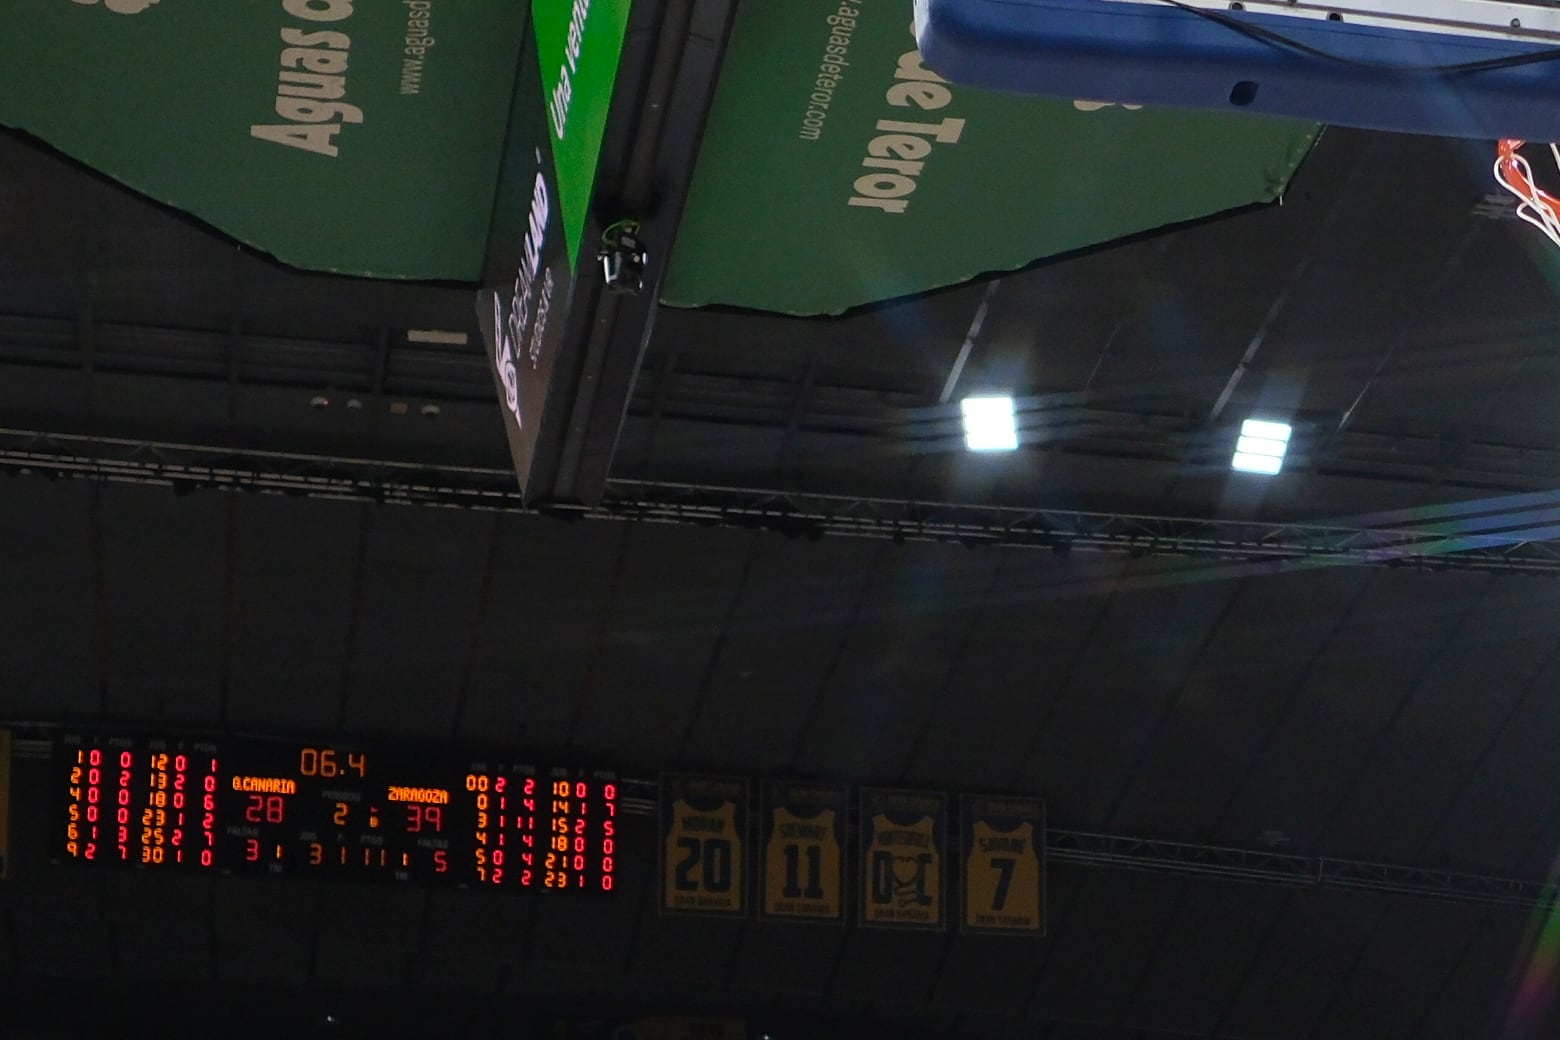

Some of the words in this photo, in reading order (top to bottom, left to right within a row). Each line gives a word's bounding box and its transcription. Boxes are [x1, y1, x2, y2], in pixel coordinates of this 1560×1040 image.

[250, 27, 364, 157] Aguas
[848, 117, 965, 213] Teror
[89, 750, 102, 767] 0
[120, 752, 132, 769] 0
[151, 754, 169, 771] 12
[175, 755, 187, 772] 0
[300, 749, 366, 778] 06.4
[70, 767, 82, 784] 2
[88, 768, 101, 785] 0
[119, 771, 131, 787] 2
[150, 773, 168, 790] 13
[174, 774, 186, 791] 2
[204, 776, 216, 793] 0
[466, 775, 489, 792] 00
[494, 777, 507, 793] 2
[523, 779, 535, 795] 2
[553, 782, 570, 798] 10
[575, 783, 587, 799] 0
[604, 785, 616, 801] 0
[69, 788, 81, 801] 4
[87, 787, 100, 804] 0
[118, 789, 130, 806] 0
[149, 791, 167, 808] 18
[173, 792, 185, 809] 0
[203, 794, 215, 811] 6
[247, 795, 284, 824] 28
[476, 794, 488, 811] 0
[523, 799, 535, 812] 4
[552, 801, 569, 814] 14
[605, 803, 615, 817] 7
[68, 804, 80, 822] 5
[86, 806, 99, 822] 0
[117, 808, 129, 824] 0
[142, 809, 166, 827] 23
[202, 813, 215, 829] 2
[334, 803, 348, 825] 2
[407, 806, 441, 832] 39
[478, 812, 488, 829] 3
[517, 817, 534, 830] 11
[552, 817, 569, 834] 15
[574, 819, 586, 835] 2
[603, 821, 614, 837] 5
[67, 823, 79, 840] 6
[118, 826, 128, 843] 3
[141, 828, 165, 845] 25
[171, 829, 183, 846] 2
[204, 832, 213, 846] 7
[476, 833, 487, 845] 4
[522, 835, 533, 847] 4
[551, 836, 569, 852] 18
[574, 837, 585, 853] 0
[603, 839, 614, 855] 0
[66, 842, 78, 857] 9
[84, 843, 96, 860] 2
[118, 845, 127, 860] 7
[142, 846, 164, 864] 30
[201, 850, 212, 866] 0
[247, 840, 260, 861] 3
[276, 844, 283, 860] 1
[309, 844, 323, 864] 3
[364, 849, 386, 868] 11
[402, 852, 410, 867] 1
[434, 851, 448, 874] 5
[475, 849, 486, 865] 5
[492, 850, 504, 866] 0
[521, 854, 533, 866] 4
[545, 853, 568, 869] 21
[573, 855, 585, 871] 0
[602, 857, 613, 873] 0
[675, 838, 731, 892] 20
[783, 845, 823, 899] 11
[477, 867, 486, 881] 7
[492, 868, 503, 884] 2
[521, 870, 532, 886] 2
[544, 872, 567, 888] 23
[601, 875, 613, 891] 0
[990, 858, 1017, 911] 7
